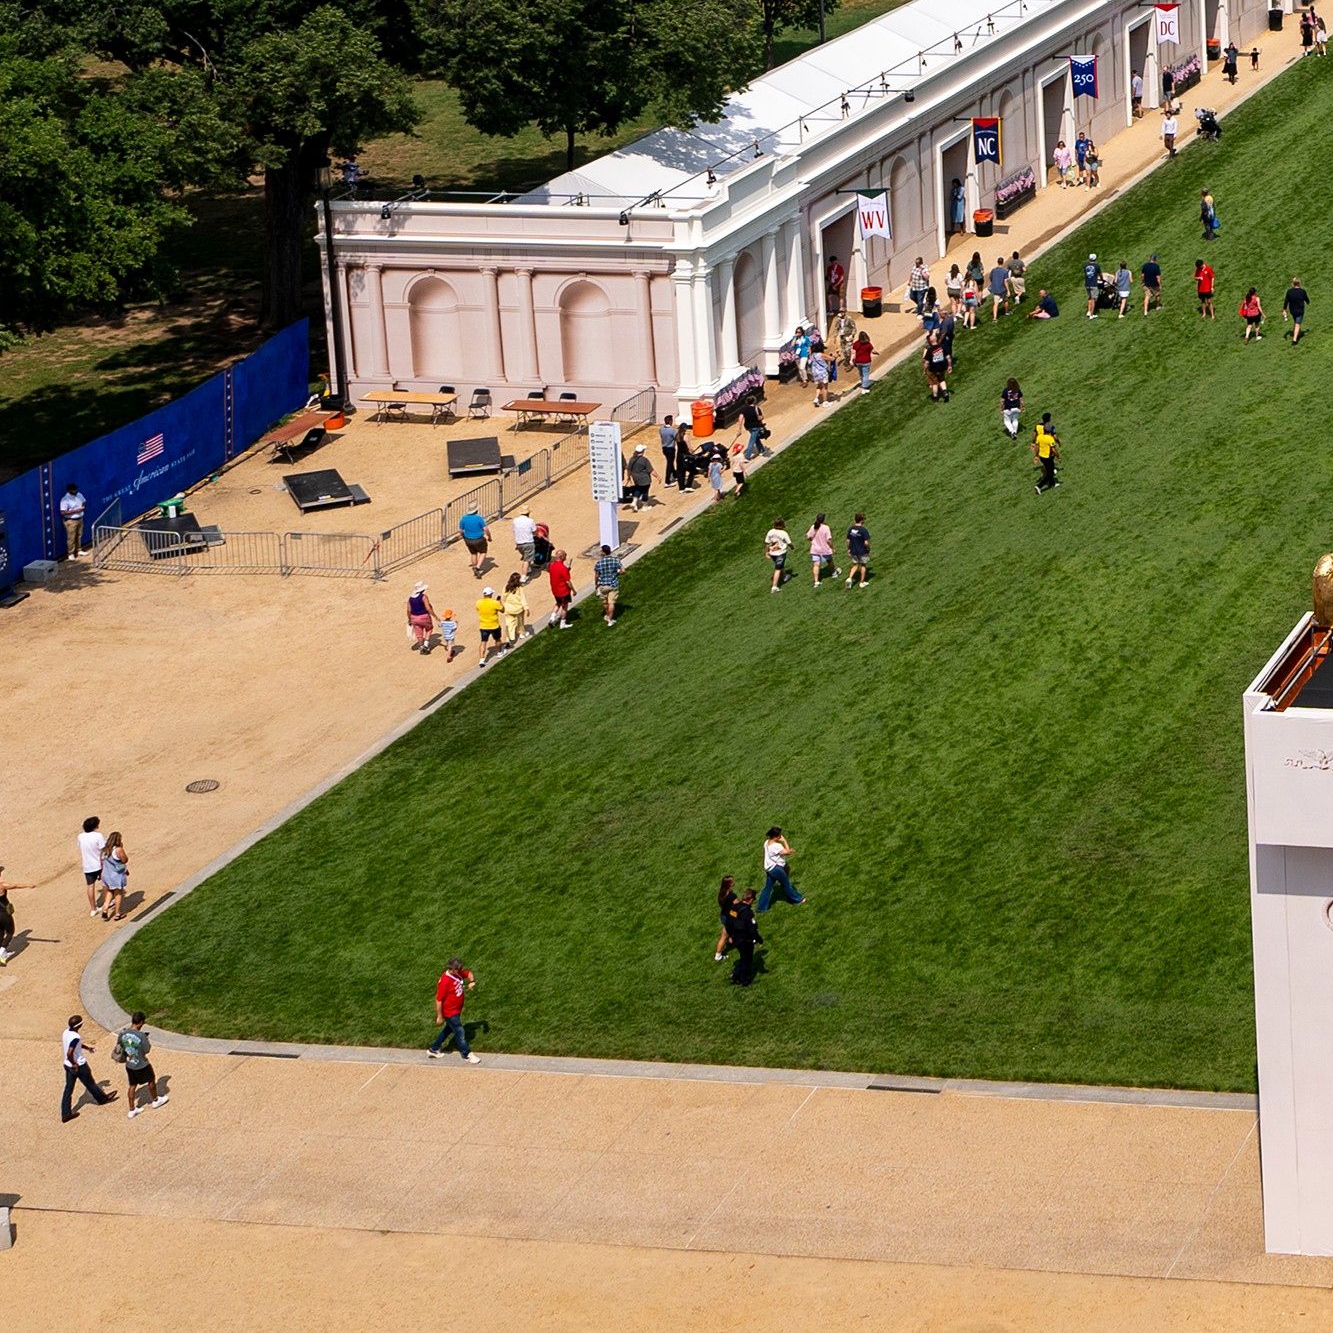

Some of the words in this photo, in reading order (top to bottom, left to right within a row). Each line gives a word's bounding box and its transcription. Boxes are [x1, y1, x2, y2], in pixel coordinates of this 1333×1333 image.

[1160, 21, 1175, 35] DC
[1074, 74, 1094, 85] 250
[978, 138, 996, 155] NC
[861, 211, 884, 229] WV
[129, 464, 169, 495] American
